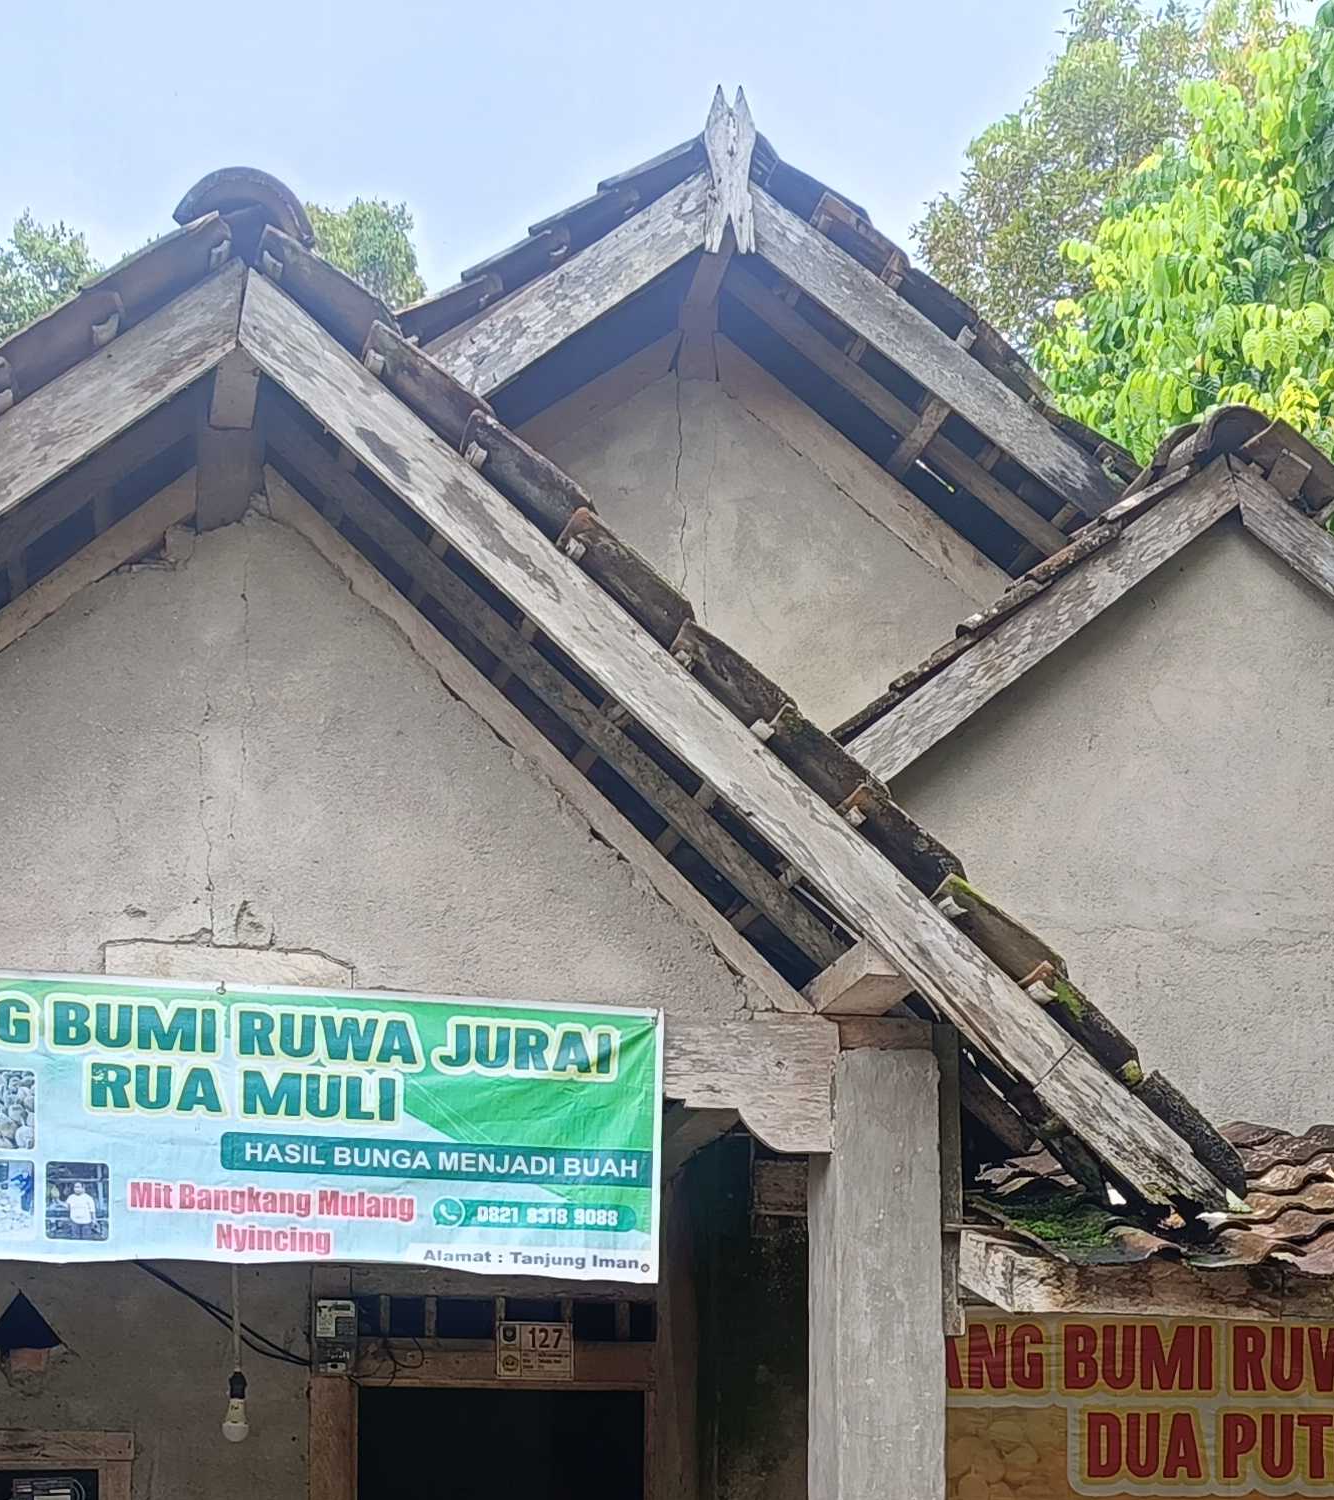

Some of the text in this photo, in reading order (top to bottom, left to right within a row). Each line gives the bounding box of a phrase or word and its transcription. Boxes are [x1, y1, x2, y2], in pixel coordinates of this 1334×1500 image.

[53, 1000, 217, 1052] BUMI
[237, 1010, 417, 1064] RUWA
[439, 1023, 612, 1074] JURAI
[91, 1062, 396, 1121] RUA MULI
[244, 1142, 638, 1179] HASIL BUNGA MENJADI BUAH
[130, 1182, 415, 1221] Mit Bangkang Mulang
[477, 1206, 619, 1226] 0821 8318 9088
[216, 1224, 331, 1255] Nyincing
[423, 1249, 491, 1264] Alamat
[512, 1252, 586, 1270] Tanjung
[592, 1255, 639, 1270] Iman
[529, 1327, 563, 1348] 127
[1064, 1325, 1213, 1391] BUMI
[1087, 1412, 1202, 1478] DUA
